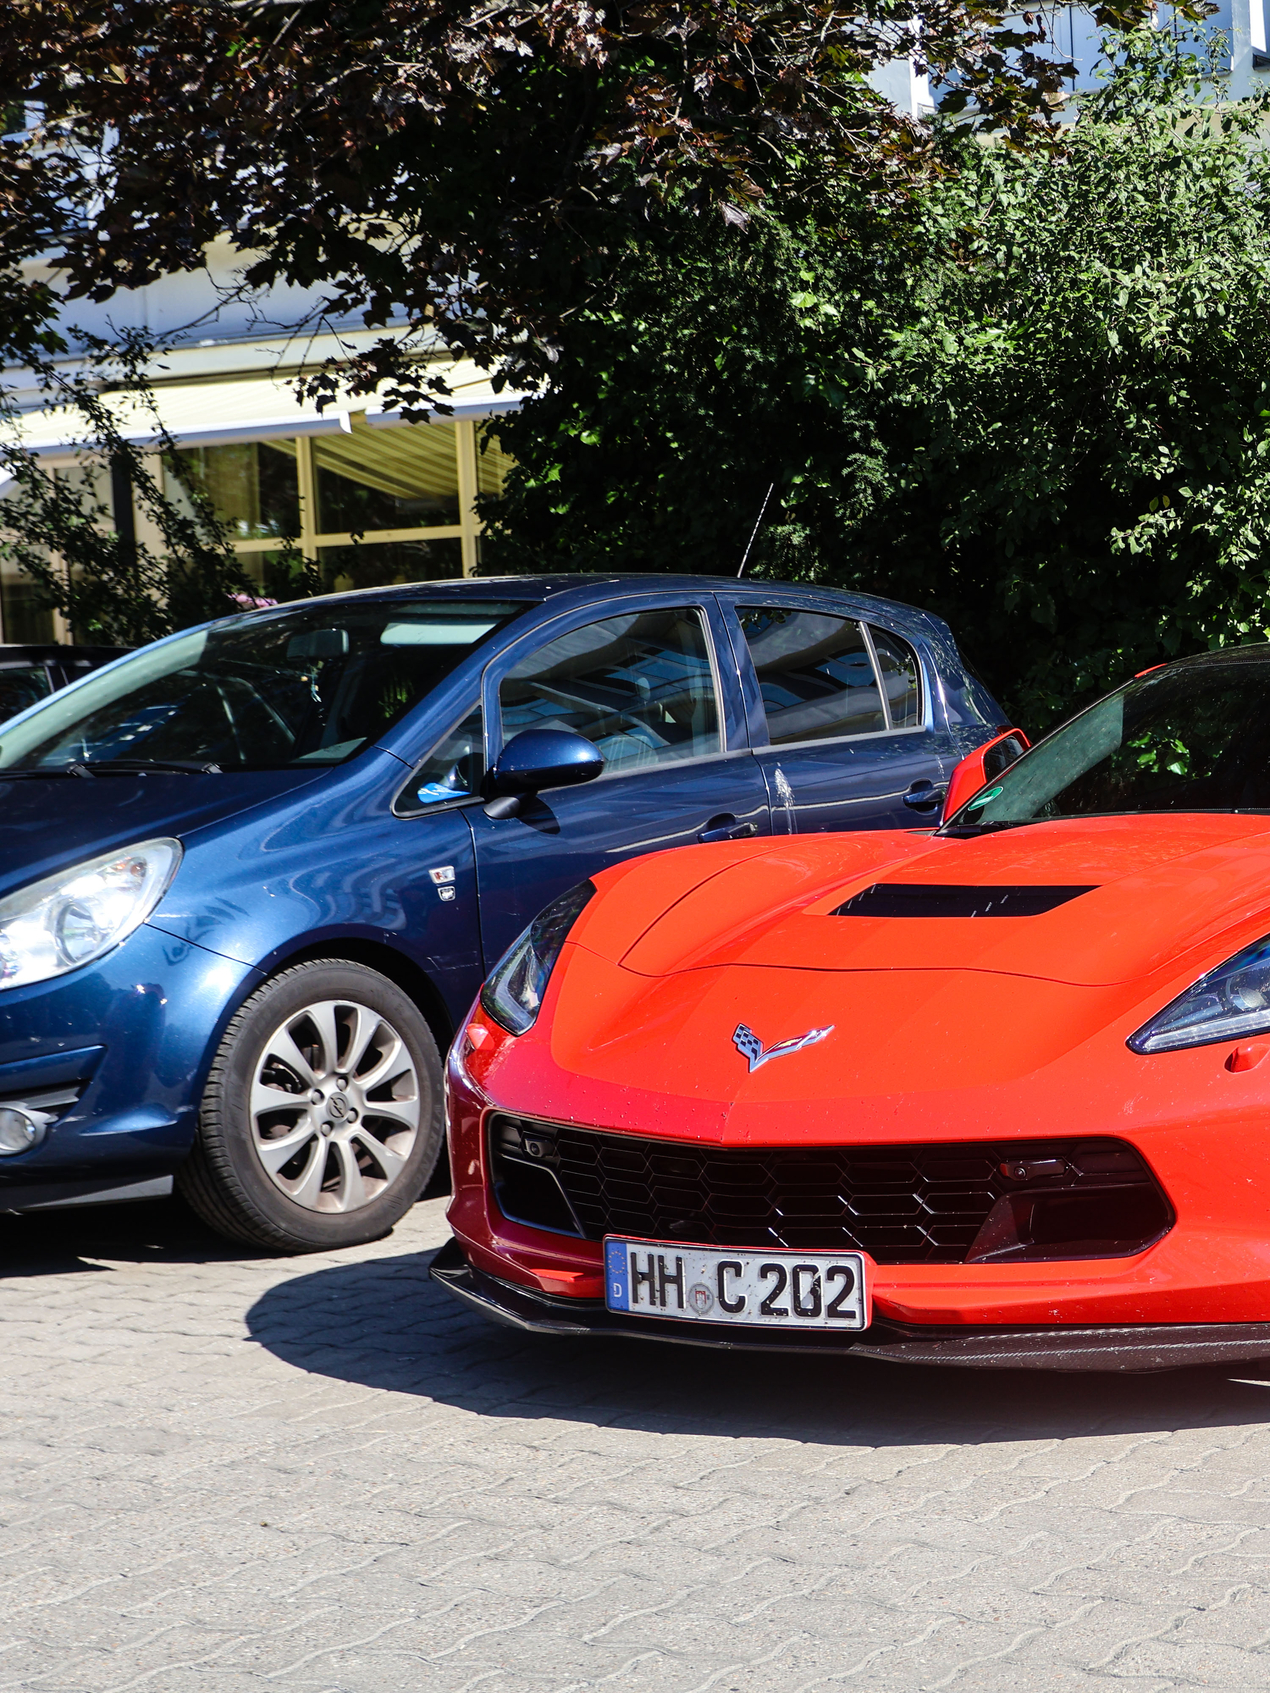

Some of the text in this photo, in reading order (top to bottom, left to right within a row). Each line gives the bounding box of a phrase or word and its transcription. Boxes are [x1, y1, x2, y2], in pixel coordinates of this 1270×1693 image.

[630, 1252, 857, 1318] HH C 202
